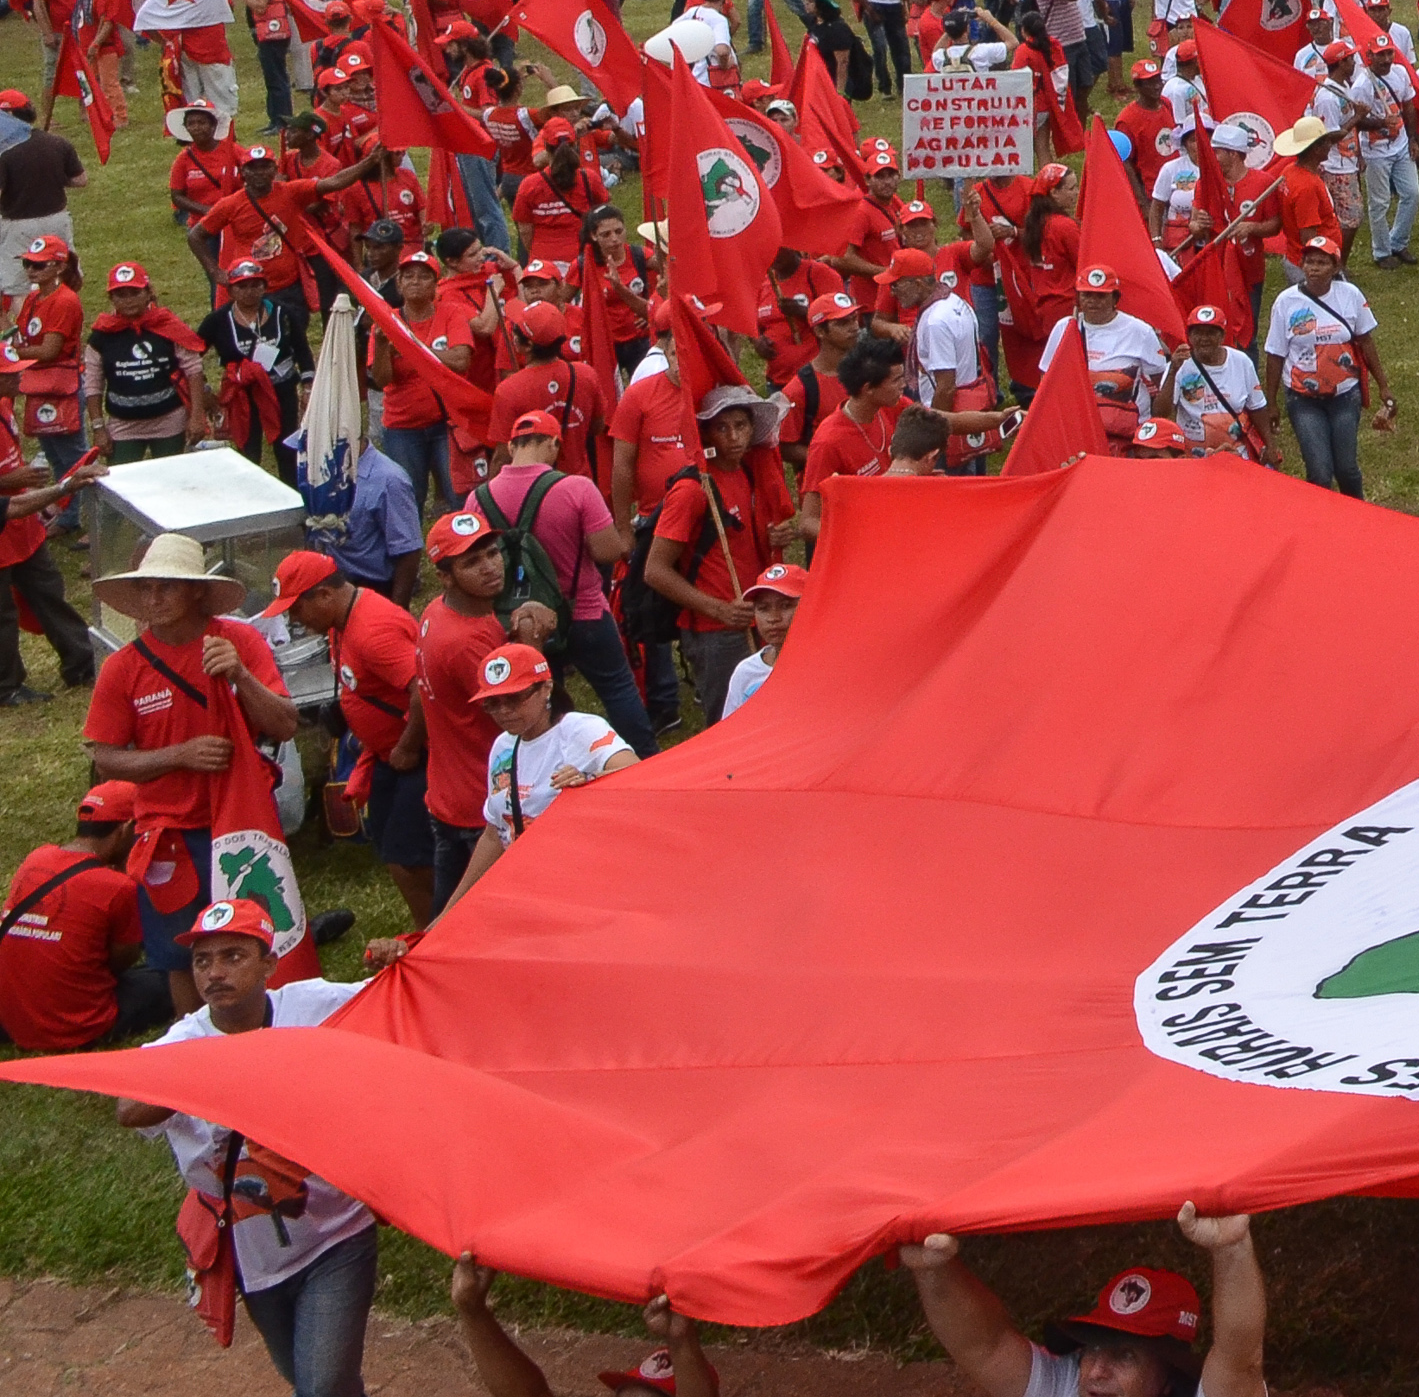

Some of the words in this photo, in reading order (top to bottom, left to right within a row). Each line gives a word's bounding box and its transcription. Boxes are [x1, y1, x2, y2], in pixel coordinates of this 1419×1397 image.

[927, 77, 997, 92] LUTAR
[907, 96, 1027, 111] CONSTRUIR
[920, 114, 1020, 130] REFORMA
[914, 133, 1016, 151] AGRÁRIA
[907, 152, 1019, 171] POPULAR
[133, 687, 172, 707] PARANÁ
[1213, 825, 1415, 930] TERRA
[1155, 936, 1264, 1001] SEM
[1161, 1002, 1361, 1079] RURAIS
